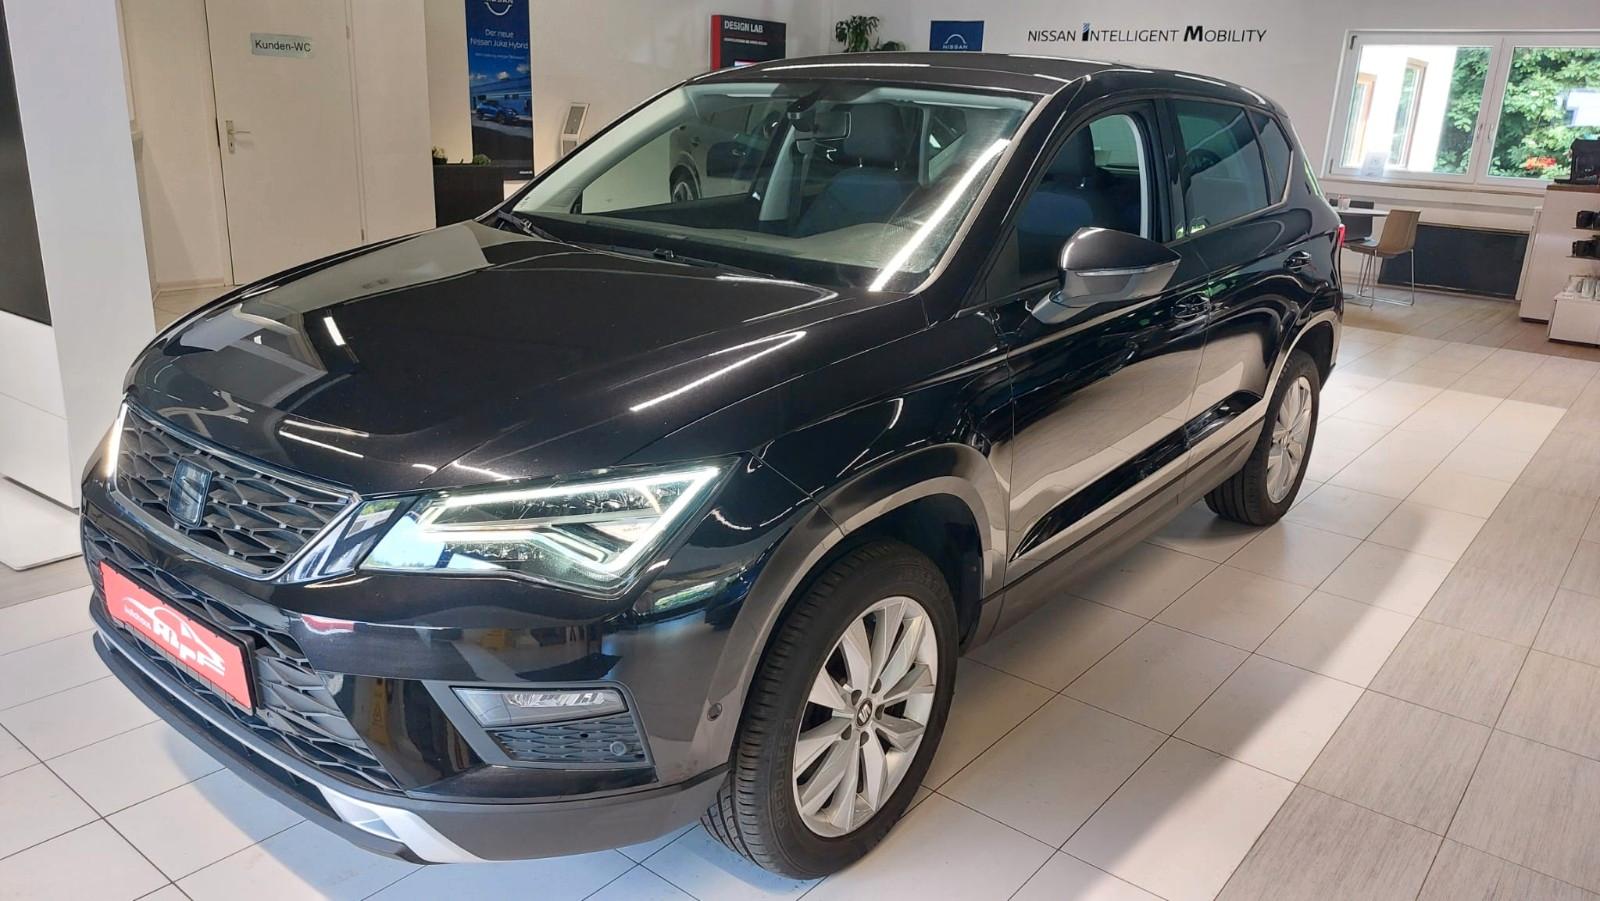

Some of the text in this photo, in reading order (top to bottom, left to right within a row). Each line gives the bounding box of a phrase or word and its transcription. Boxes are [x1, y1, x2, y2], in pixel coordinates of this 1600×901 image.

[724, 20, 764, 33] DESIGN LAB
[1027, 22, 1267, 42] NISSAN INTELLIGENT MOBILITY
[485, 28, 514, 39] Der neue
[255, 39, 311, 52] Kunden-WC
[470, 37, 493, 46] Nissan
[508, 41, 528, 49] Hybrid
